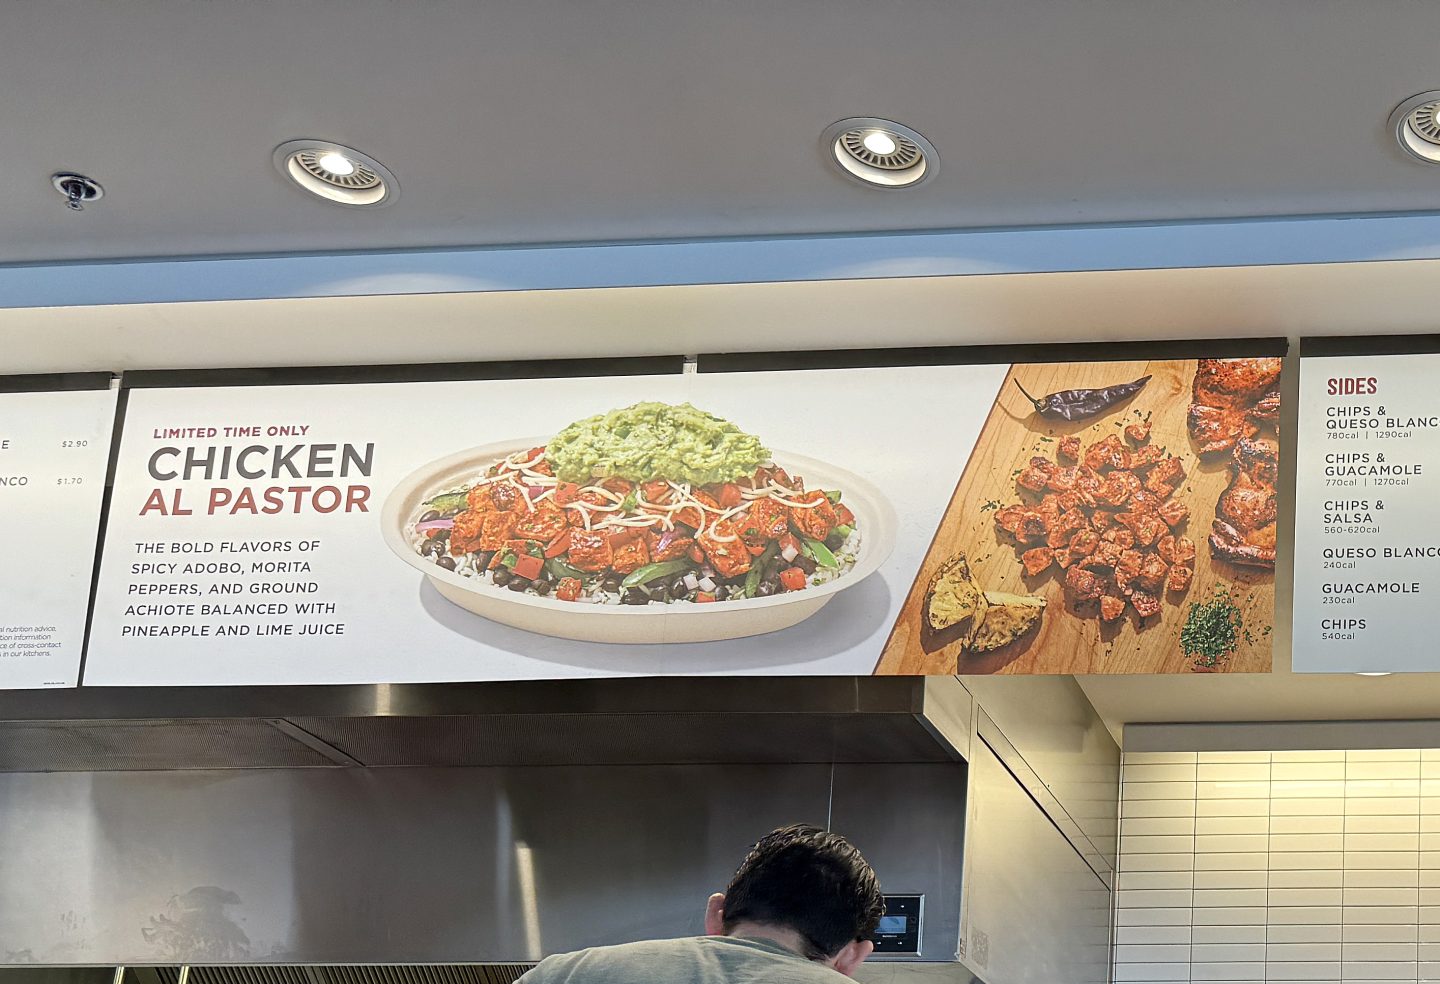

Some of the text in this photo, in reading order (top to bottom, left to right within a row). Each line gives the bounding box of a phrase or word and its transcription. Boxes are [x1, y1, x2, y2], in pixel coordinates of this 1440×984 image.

[1327, 377, 1377, 395] SIDES
[1326, 406, 1386, 417] CHIPS &
[1326, 418, 1379, 430] QUESO
[154, 425, 309, 438] LIMITED TIME ONLY
[1327, 430, 1411, 439] 780cal 1290cal
[148, 443, 375, 481] CHICKEN
[1326, 453, 1385, 464] CHIPS &
[1325, 465, 1422, 476] GUACAMOLE
[57, 477, 82, 485] $1.70
[1326, 477, 1409, 486] 770cal 1270cal
[139, 485, 371, 516] AL PASTOR
[1324, 500, 1384, 511] CHIPS &
[1324, 513, 1373, 523] SALSA
[1324, 526, 1380, 534] 560-620cal
[135, 541, 320, 553] THE BOLD FLAVORS OF
[1323, 548, 1377, 560] QUESO
[131, 562, 312, 576] SPICY ADOBO, MORITA
[1323, 561, 1356, 569] 240cal
[128, 583, 318, 597] PEPPERS, AND GROUND
[1322, 583, 1420, 594] GUACAMOLE
[1323, 596, 1355, 604] 230cal
[125, 603, 336, 616] ACHIOTE BALANCED WITH
[1321, 619, 1366, 630] CHIPS
[122, 624, 345, 637] PINEAPPLE AND LIME JUICE
[1322, 632, 1355, 640] 540cal
